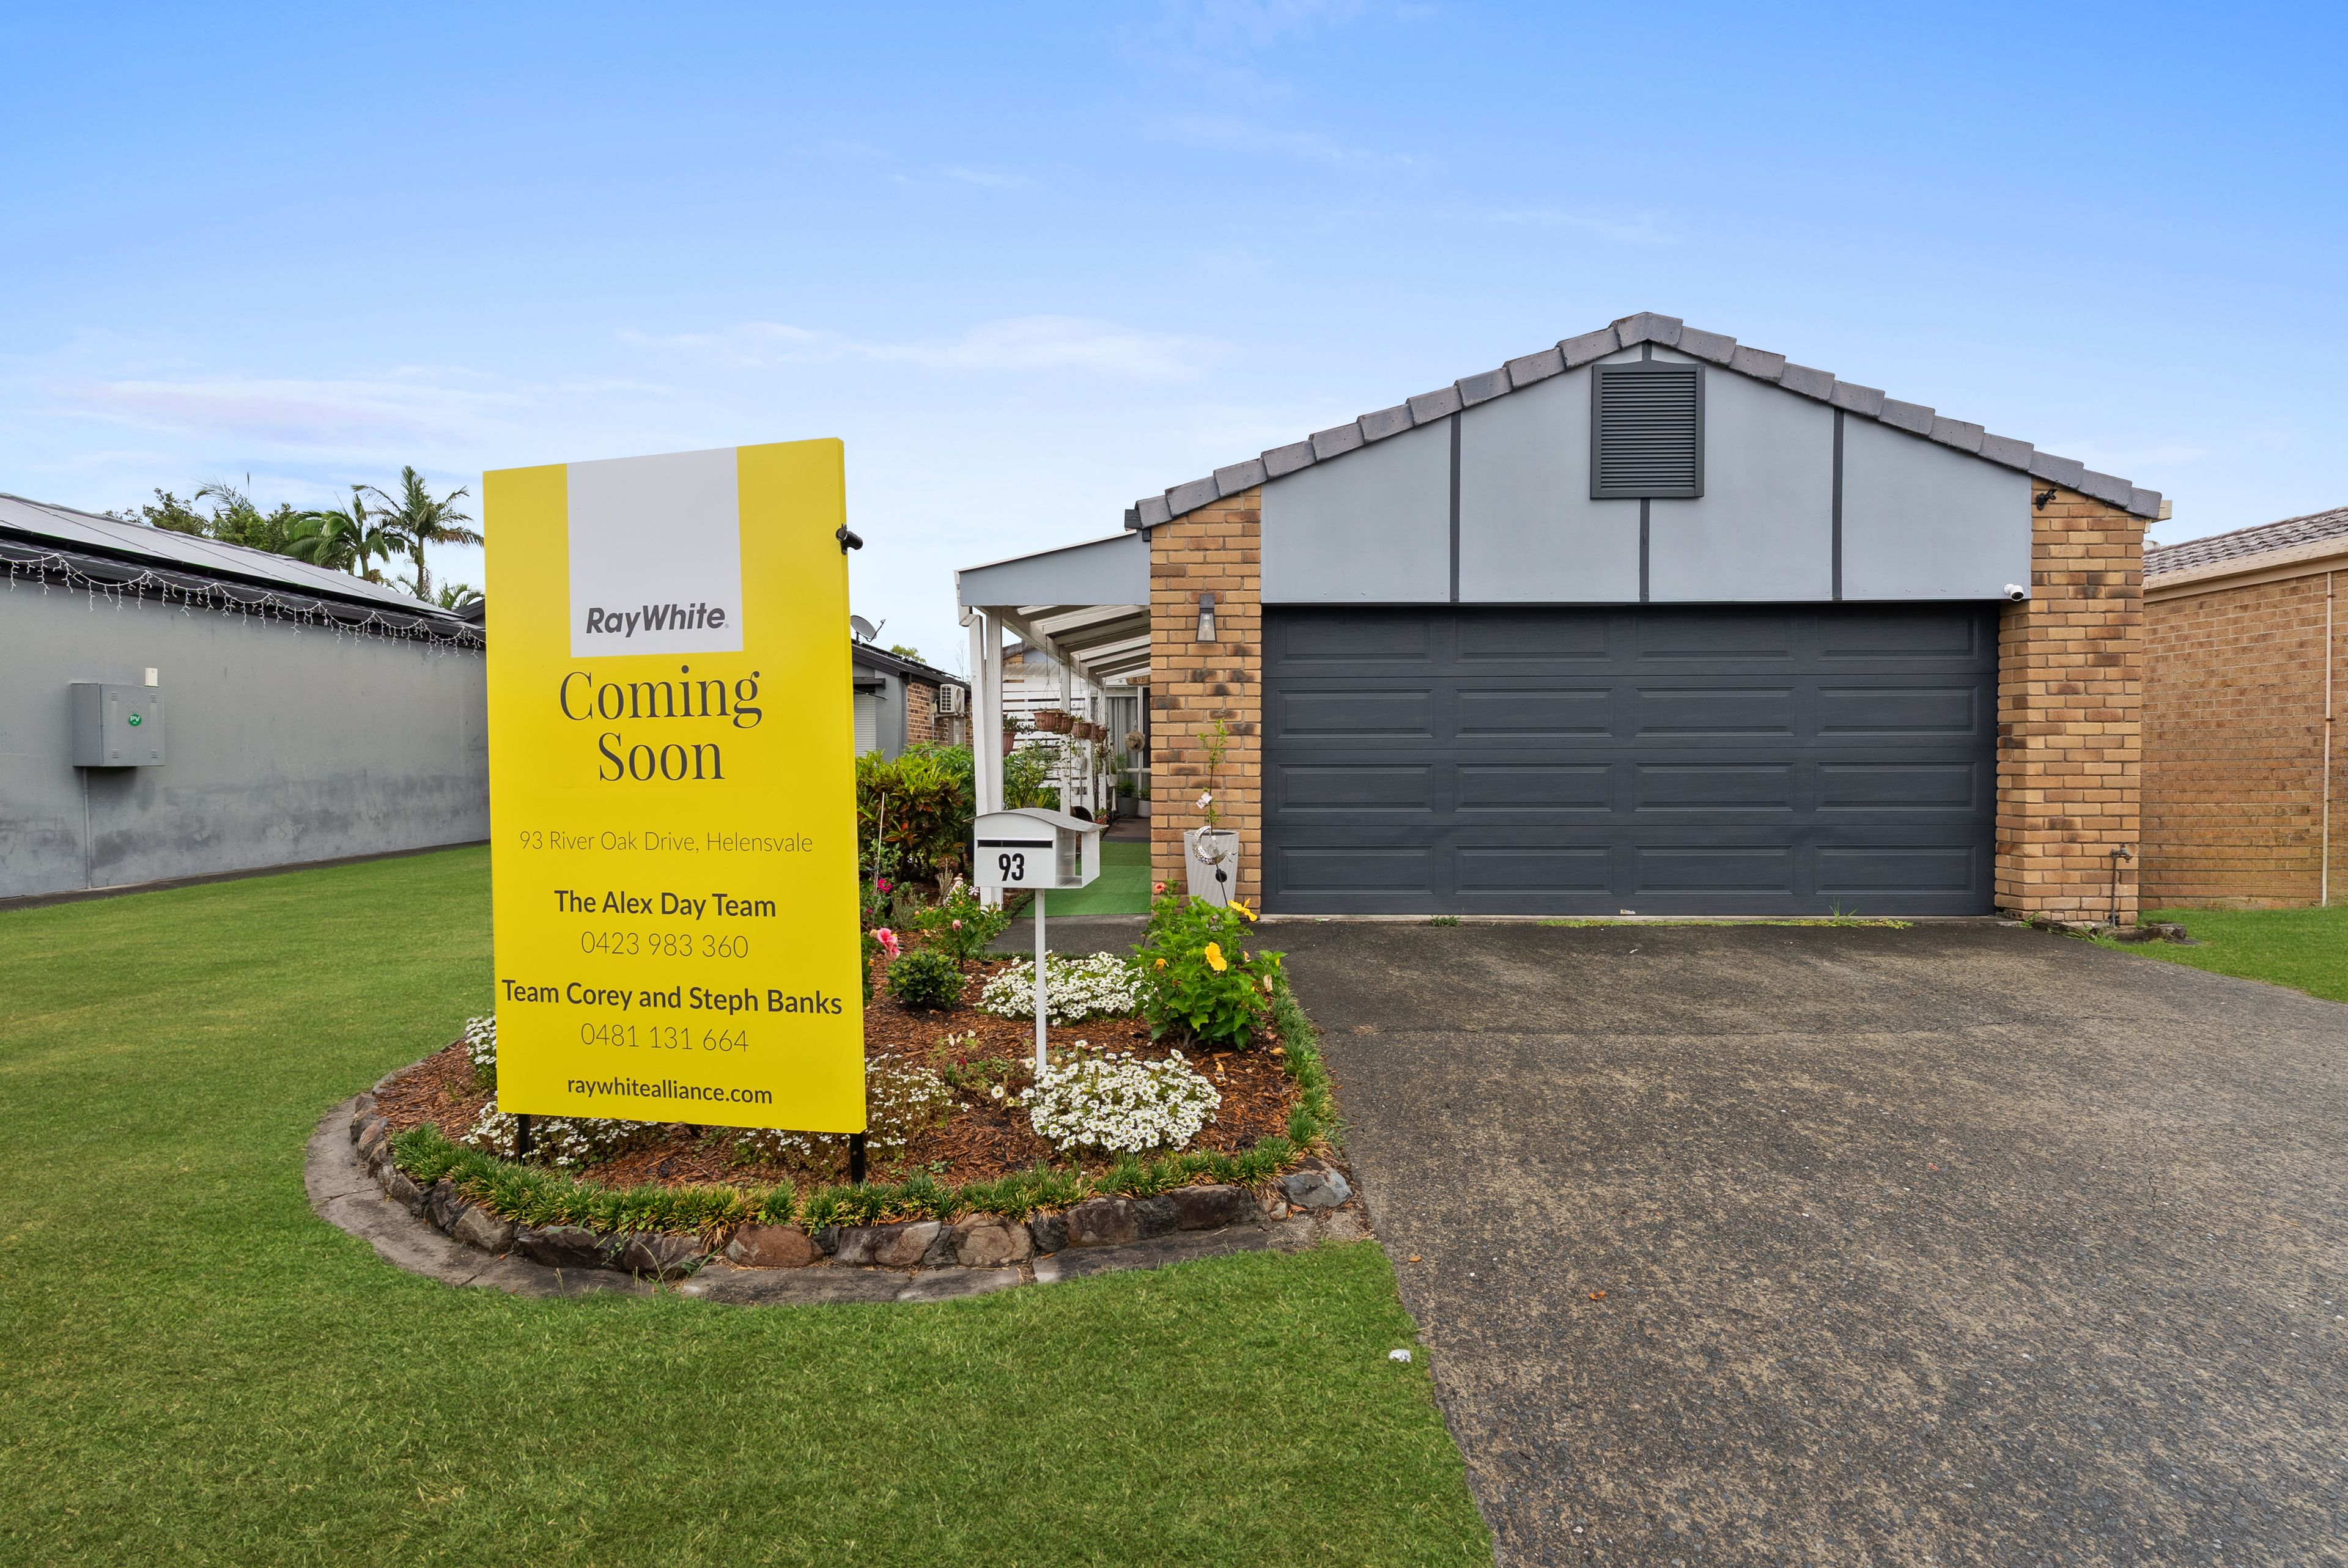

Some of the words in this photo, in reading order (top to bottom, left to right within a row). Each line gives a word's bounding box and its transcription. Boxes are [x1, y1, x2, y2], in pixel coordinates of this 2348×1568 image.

[586, 602, 725, 638] RayWhite
[560, 665, 762, 728] Coming
[599, 732, 725, 781] Soon
[520, 831, 543, 850] 93
[550, 831, 595, 850] River
[600, 831, 638, 850] Oak
[645, 831, 699, 853] Drive,
[707, 832, 813, 852] Helensvale
[999, 853, 1025, 882] 93
[554, 890, 596, 913] The
[602, 891, 653, 914] Alex
[661, 892, 706, 920] Day
[712, 893, 776, 917] Team
[581, 931, 640, 955] 0423
[648, 933, 693, 957] 983
[702, 935, 748, 959] 360
[502, 979, 559, 1003] Team
[567, 982, 633, 1011] Corey
[639, 986, 681, 1008] and
[689, 987, 759, 1015] Steph
[768, 989, 843, 1014] Banks
[581, 1023, 640, 1047] 0481
[649, 1026, 693, 1050] 131
[703, 1028, 749, 1053] 664
[567, 1077, 772, 1104] raywhitealliance.com
